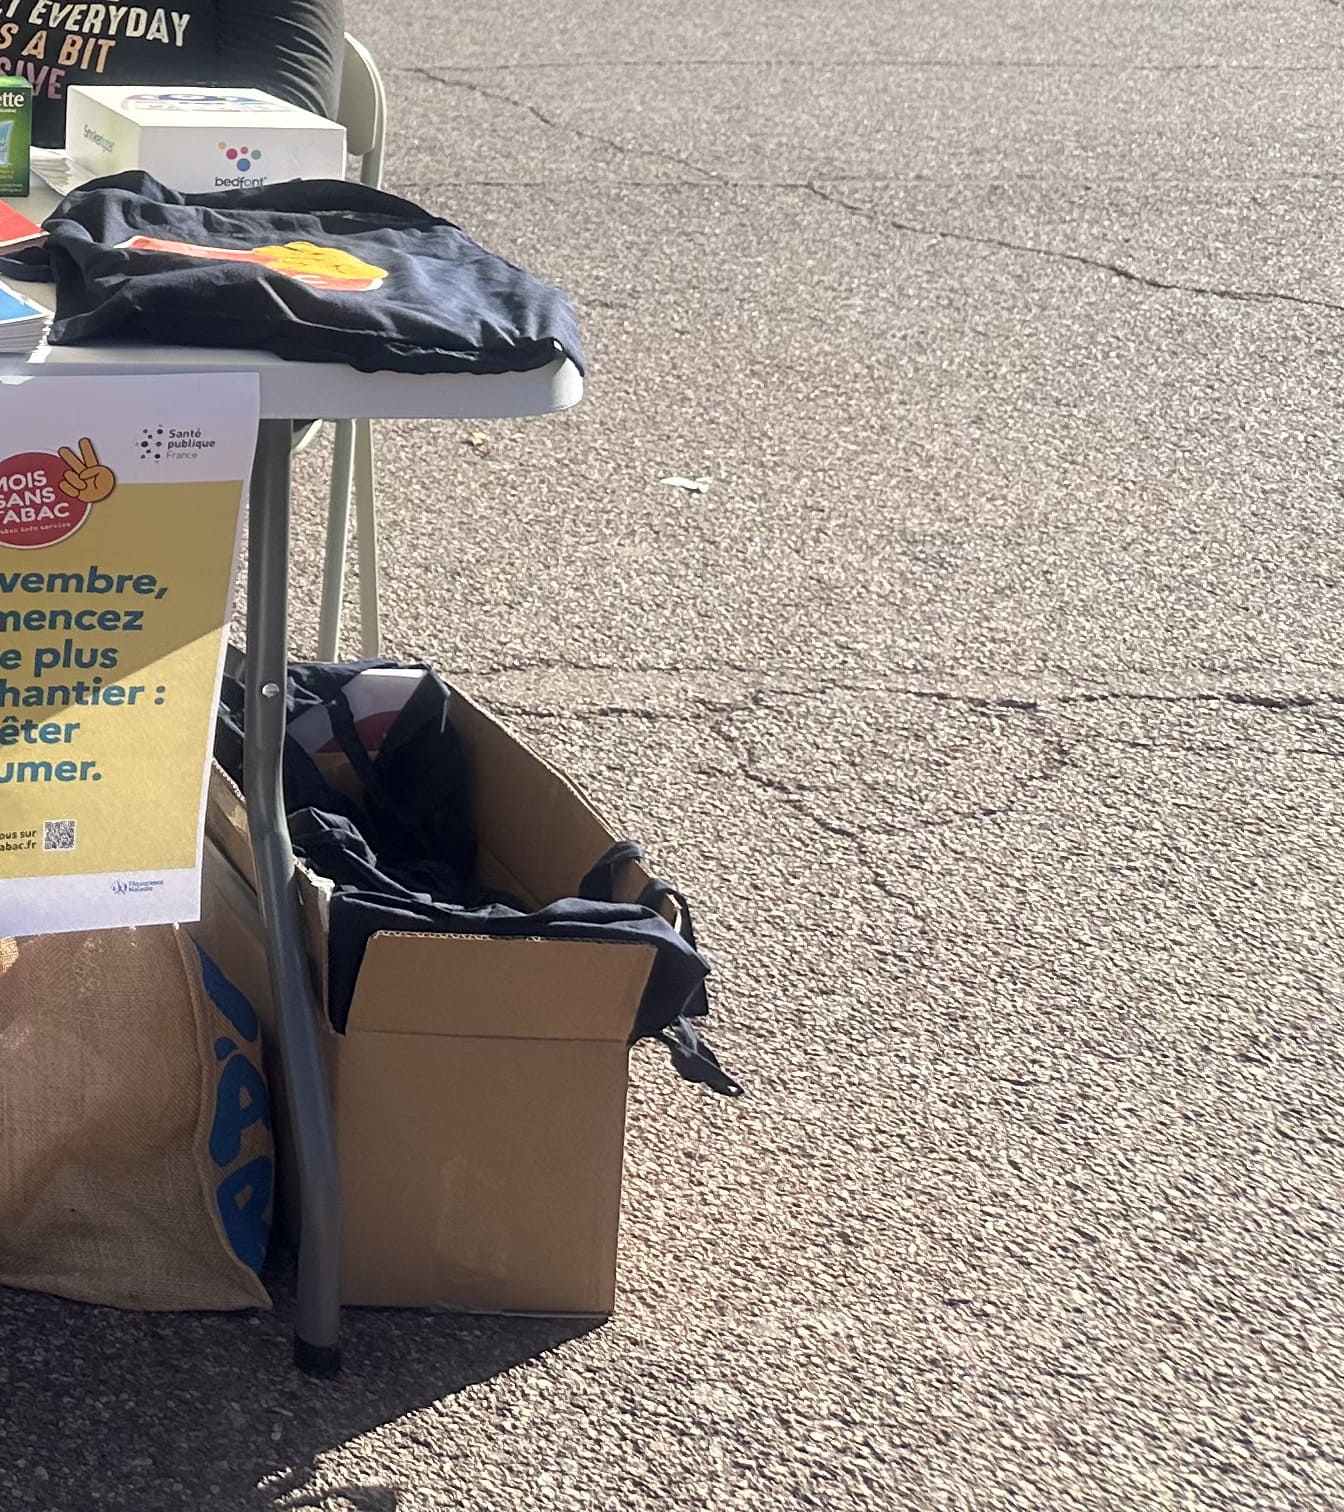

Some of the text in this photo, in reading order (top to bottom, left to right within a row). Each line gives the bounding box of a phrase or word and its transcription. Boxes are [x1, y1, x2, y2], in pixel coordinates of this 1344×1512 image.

[21, 30, 48, 60] A
[58, 33, 117, 73] BIT
[168, 428, 202, 439] Santé
[167, 439, 216, 450] publique
[34, 639, 119, 677] plus
[20, 829, 37, 838] sur
